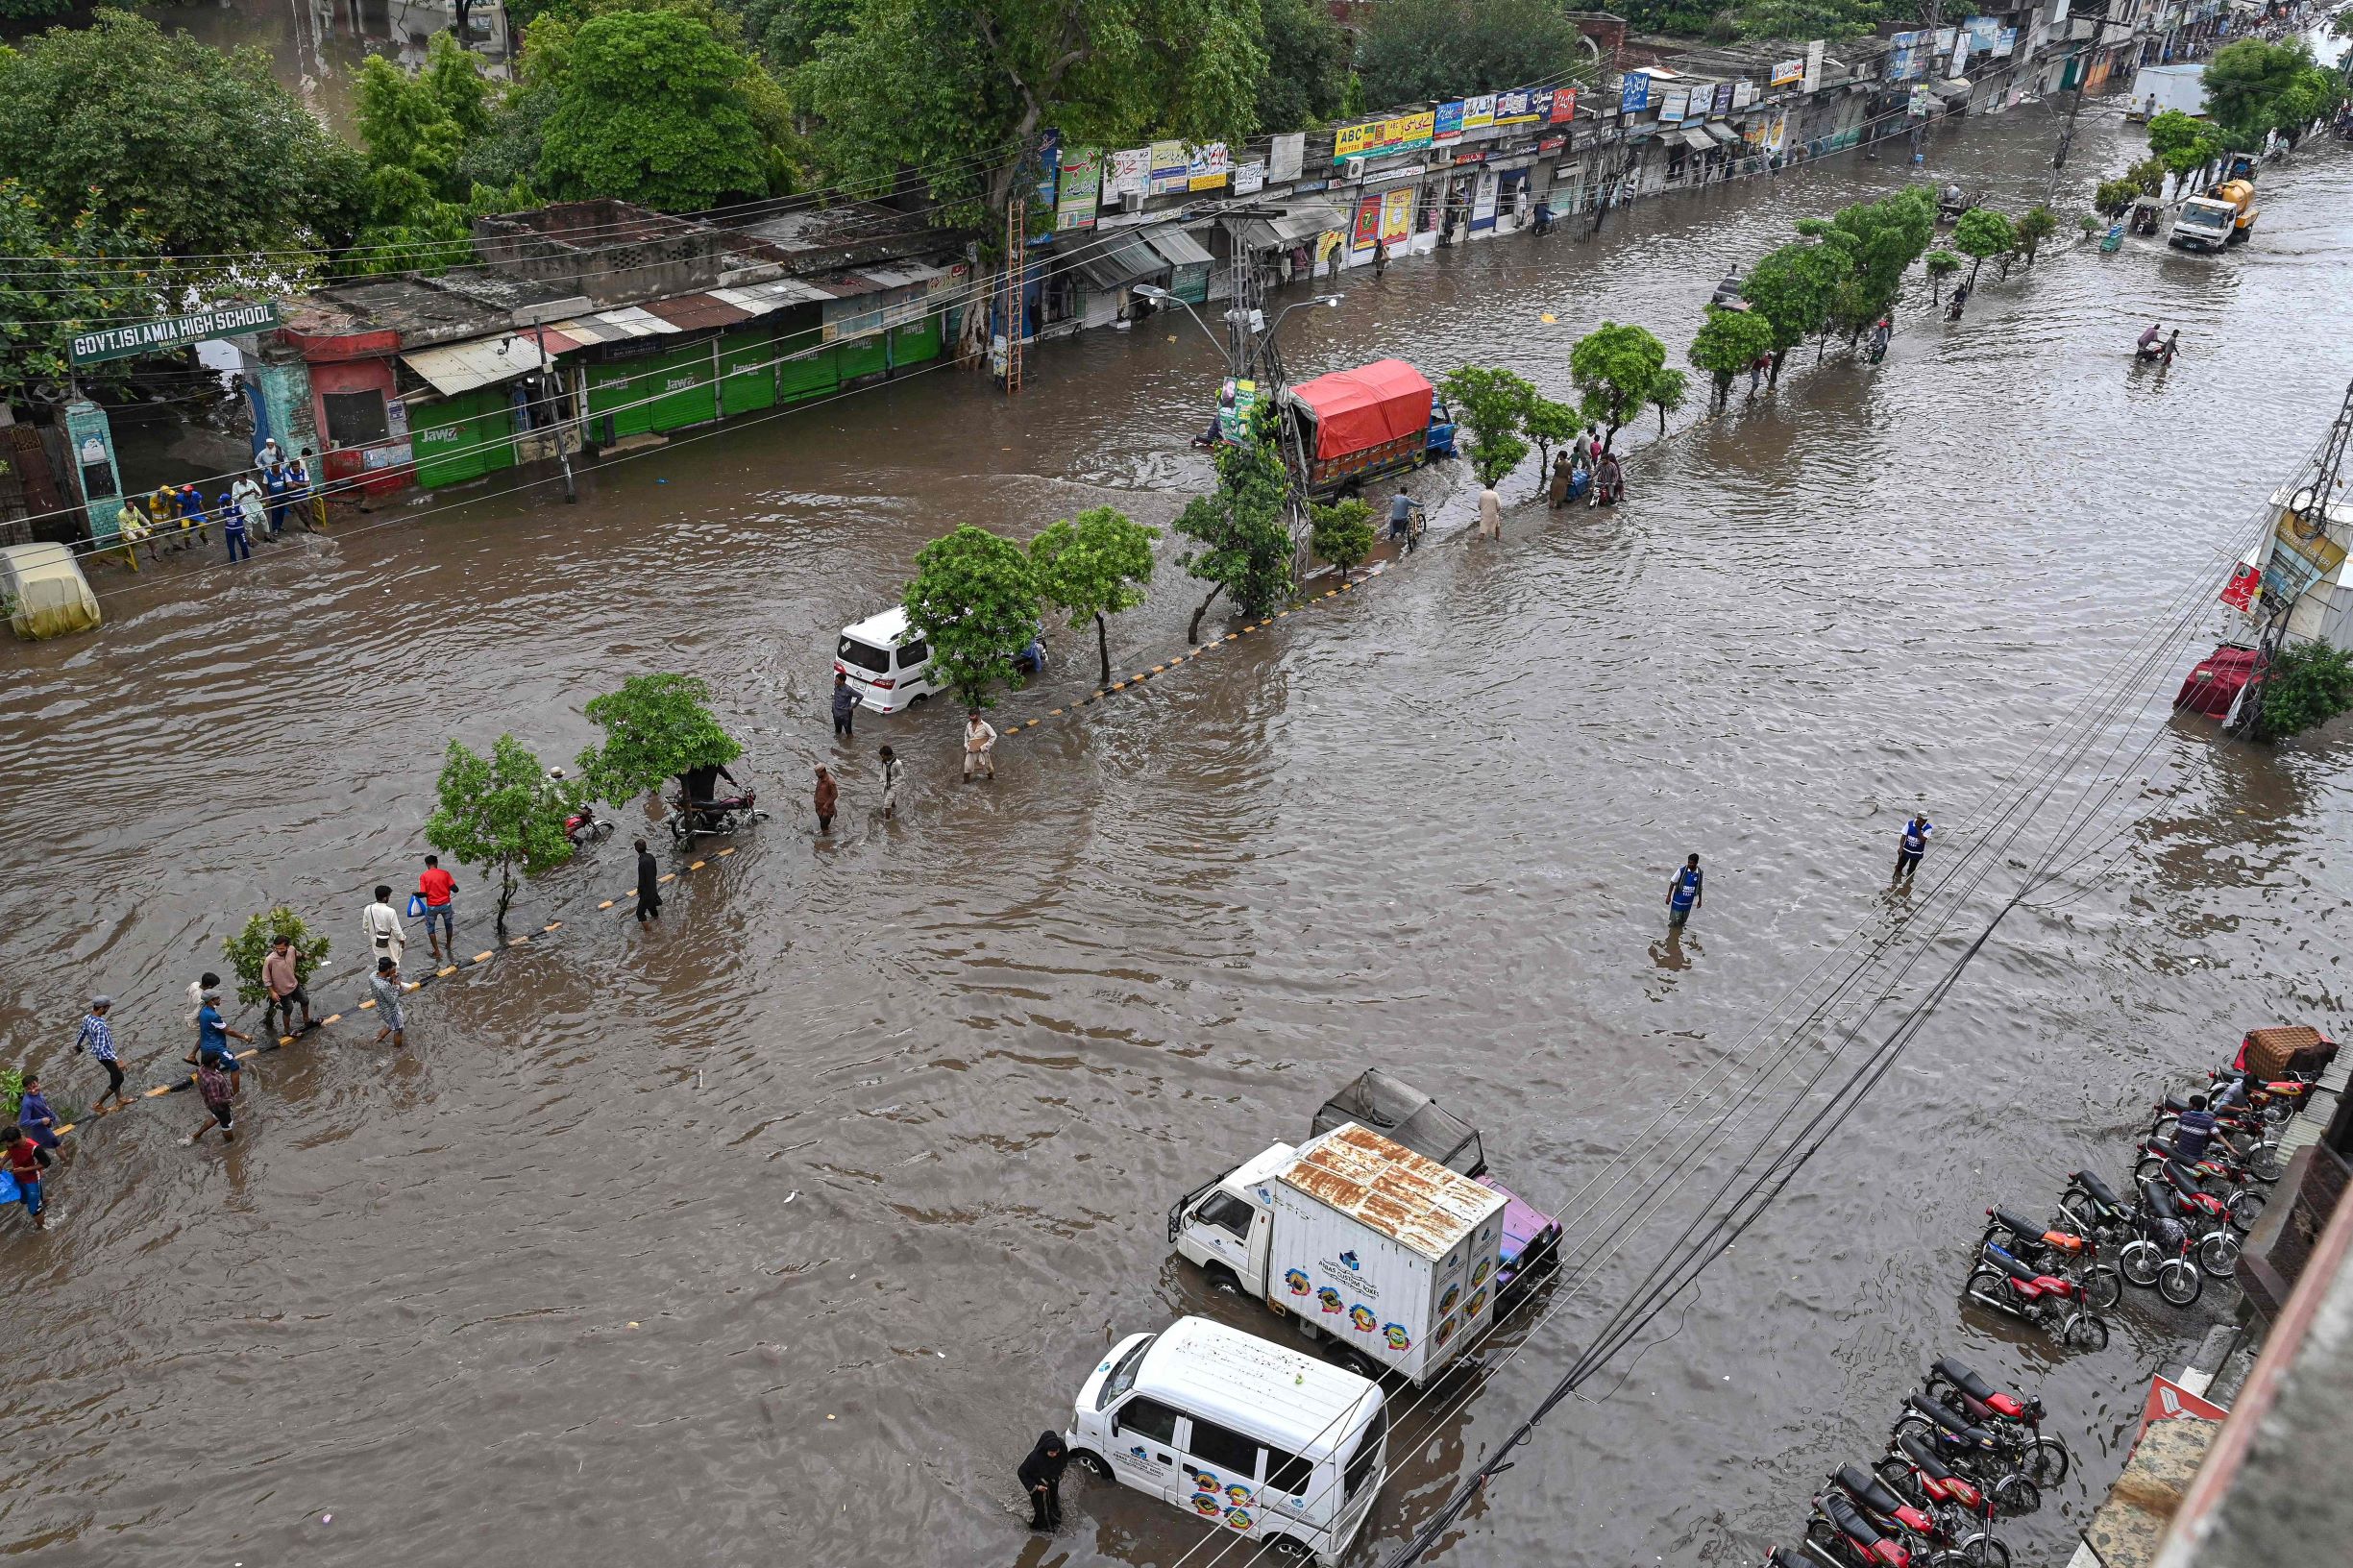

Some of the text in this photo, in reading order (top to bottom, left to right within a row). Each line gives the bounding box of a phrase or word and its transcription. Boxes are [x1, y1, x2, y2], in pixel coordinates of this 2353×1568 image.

[1340, 128, 1362, 144] ABC
[178, 313, 214, 337] HIGH
[215, 305, 274, 331] SCHOOL
[180, 336, 195, 345] GATE
[421, 428, 456, 442] Jawa
[2306, 546, 2331, 567] TOWER
[1336, 1270, 1360, 1288] CUSTOM
[1128, 1458, 1149, 1471] CUSTOM
